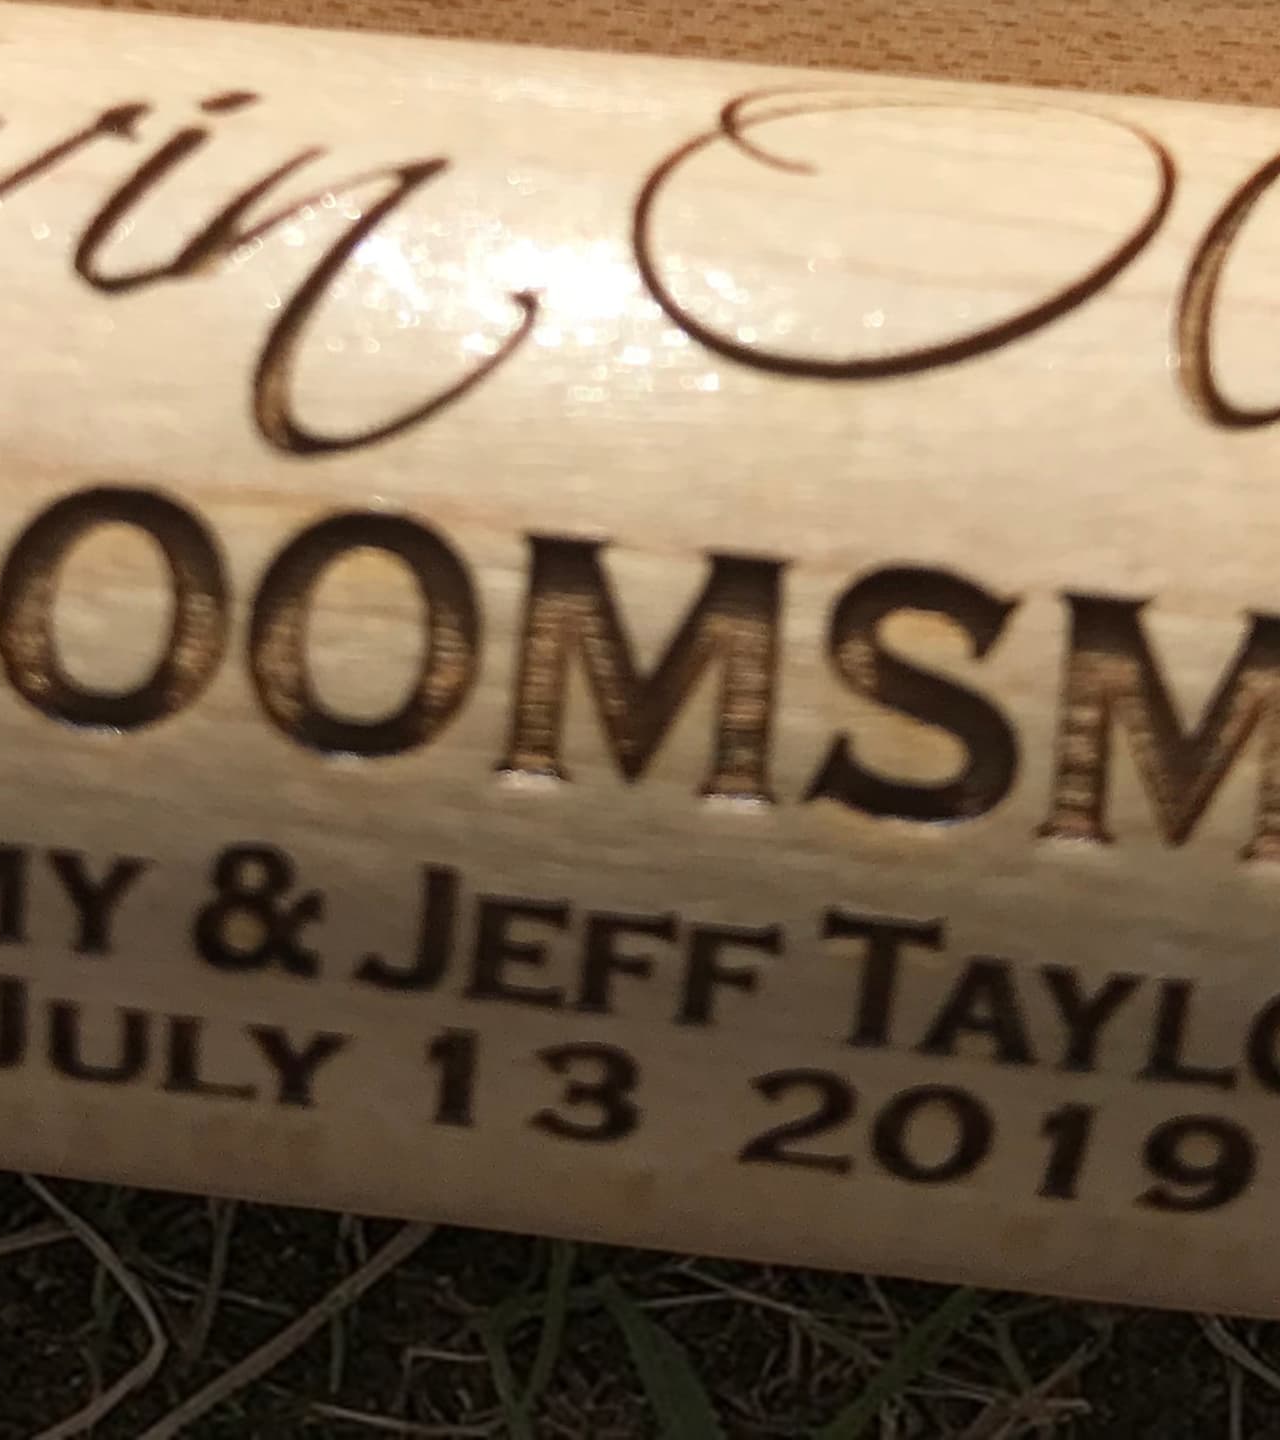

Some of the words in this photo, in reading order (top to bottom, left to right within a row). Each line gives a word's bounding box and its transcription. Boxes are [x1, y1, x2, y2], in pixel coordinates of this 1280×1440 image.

[190, 839, 326, 982] &
[355, 861, 786, 1028] JEFF
[424, 1024, 643, 1144] 13
[735, 1066, 1261, 1215] 2019
